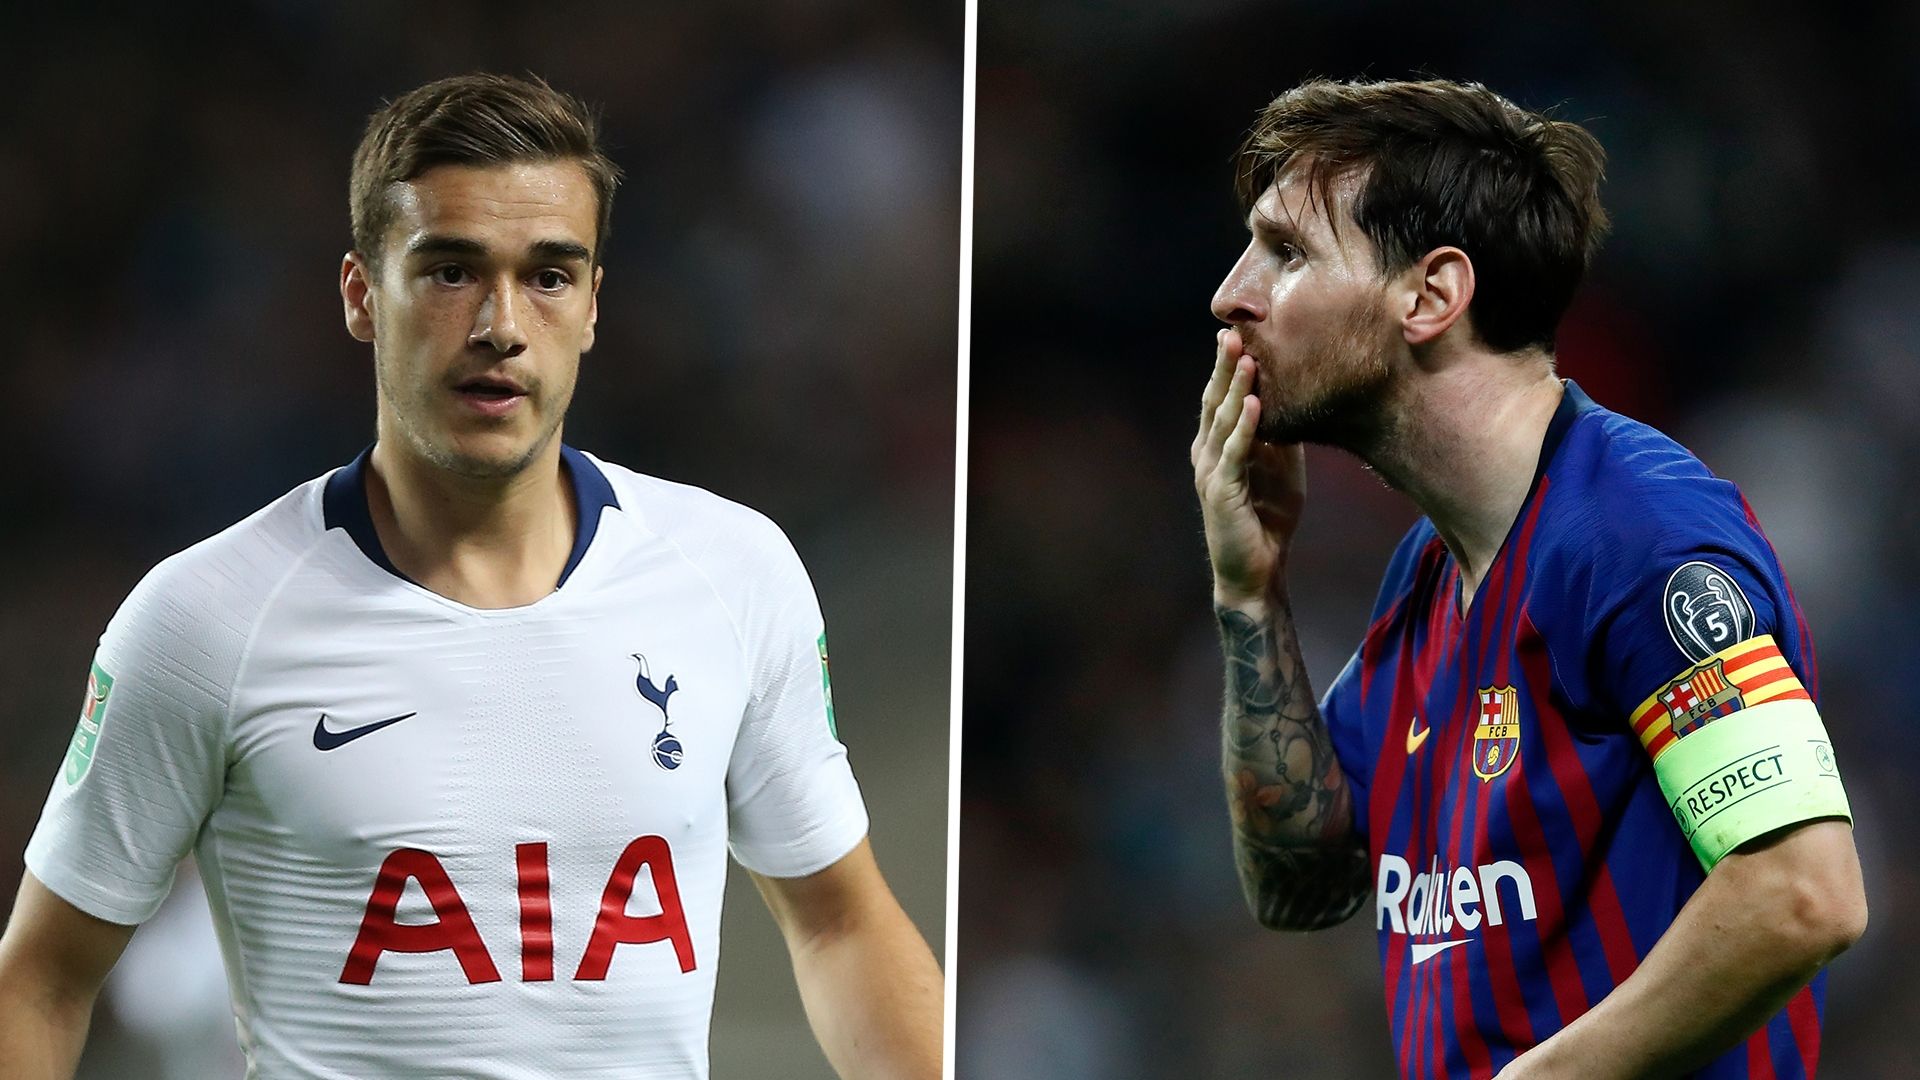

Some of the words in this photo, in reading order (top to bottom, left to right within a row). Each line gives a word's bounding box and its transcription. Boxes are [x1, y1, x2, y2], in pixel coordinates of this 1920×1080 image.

[1705, 611, 1728, 642] 5
[1689, 698, 1717, 719] FCB
[1489, 726, 1507, 737] FCB
[1687, 754, 1782, 819] RESPECT
[339, 834, 697, 985] AIA
